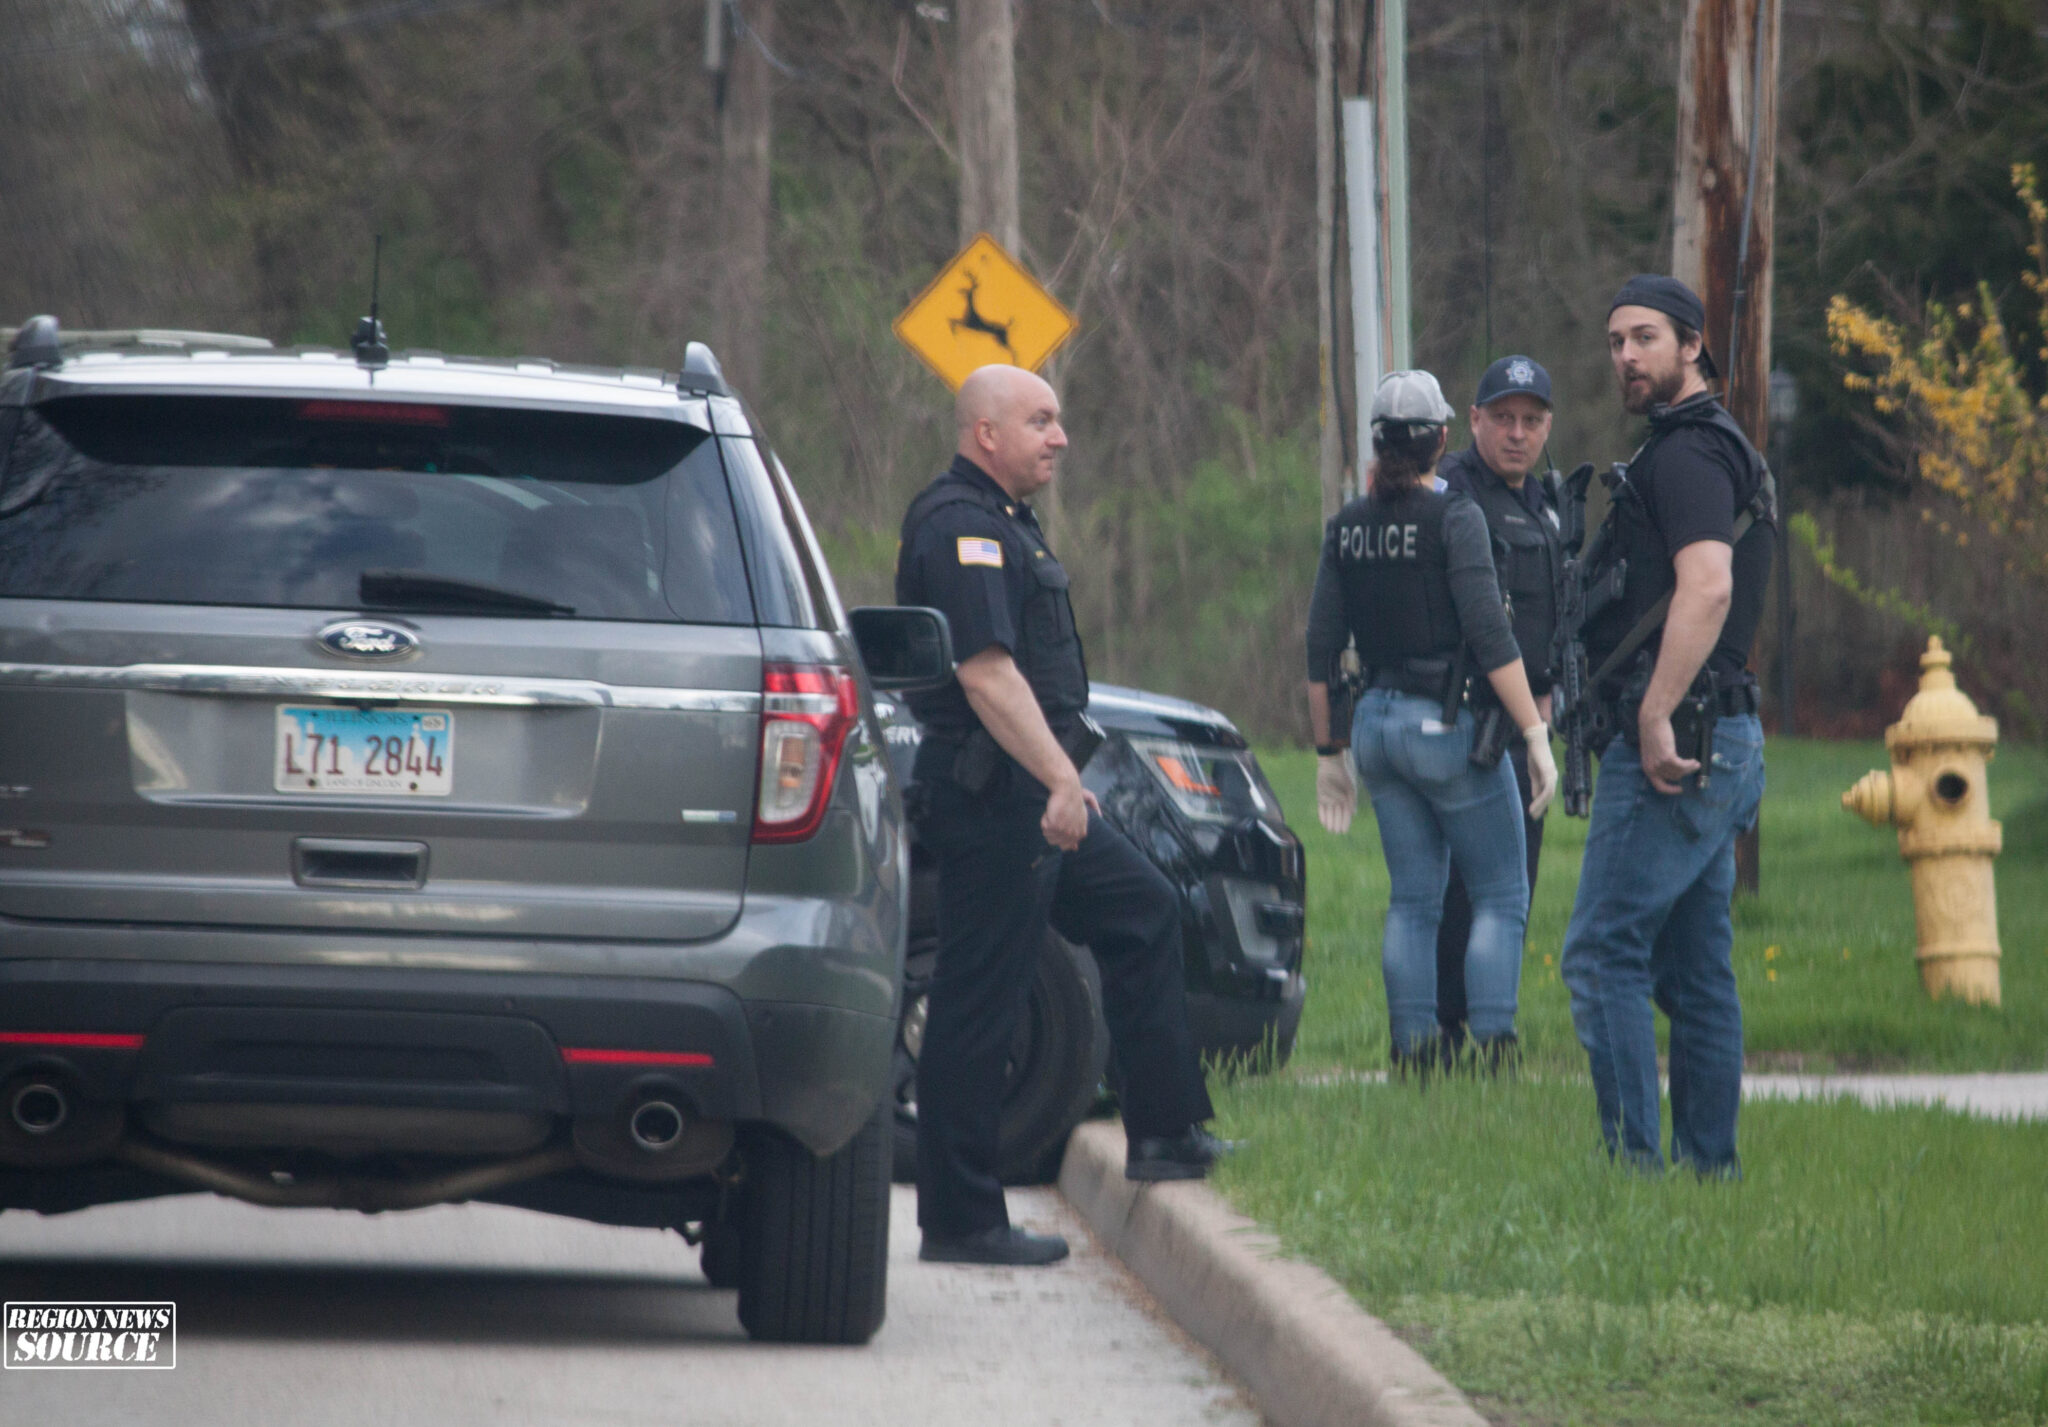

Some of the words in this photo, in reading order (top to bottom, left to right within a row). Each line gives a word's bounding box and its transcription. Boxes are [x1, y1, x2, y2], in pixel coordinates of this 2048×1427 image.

[1340, 524, 1418, 559] POLICE
[286, 732, 343, 775] L71
[364, 734, 443, 777] 2844
